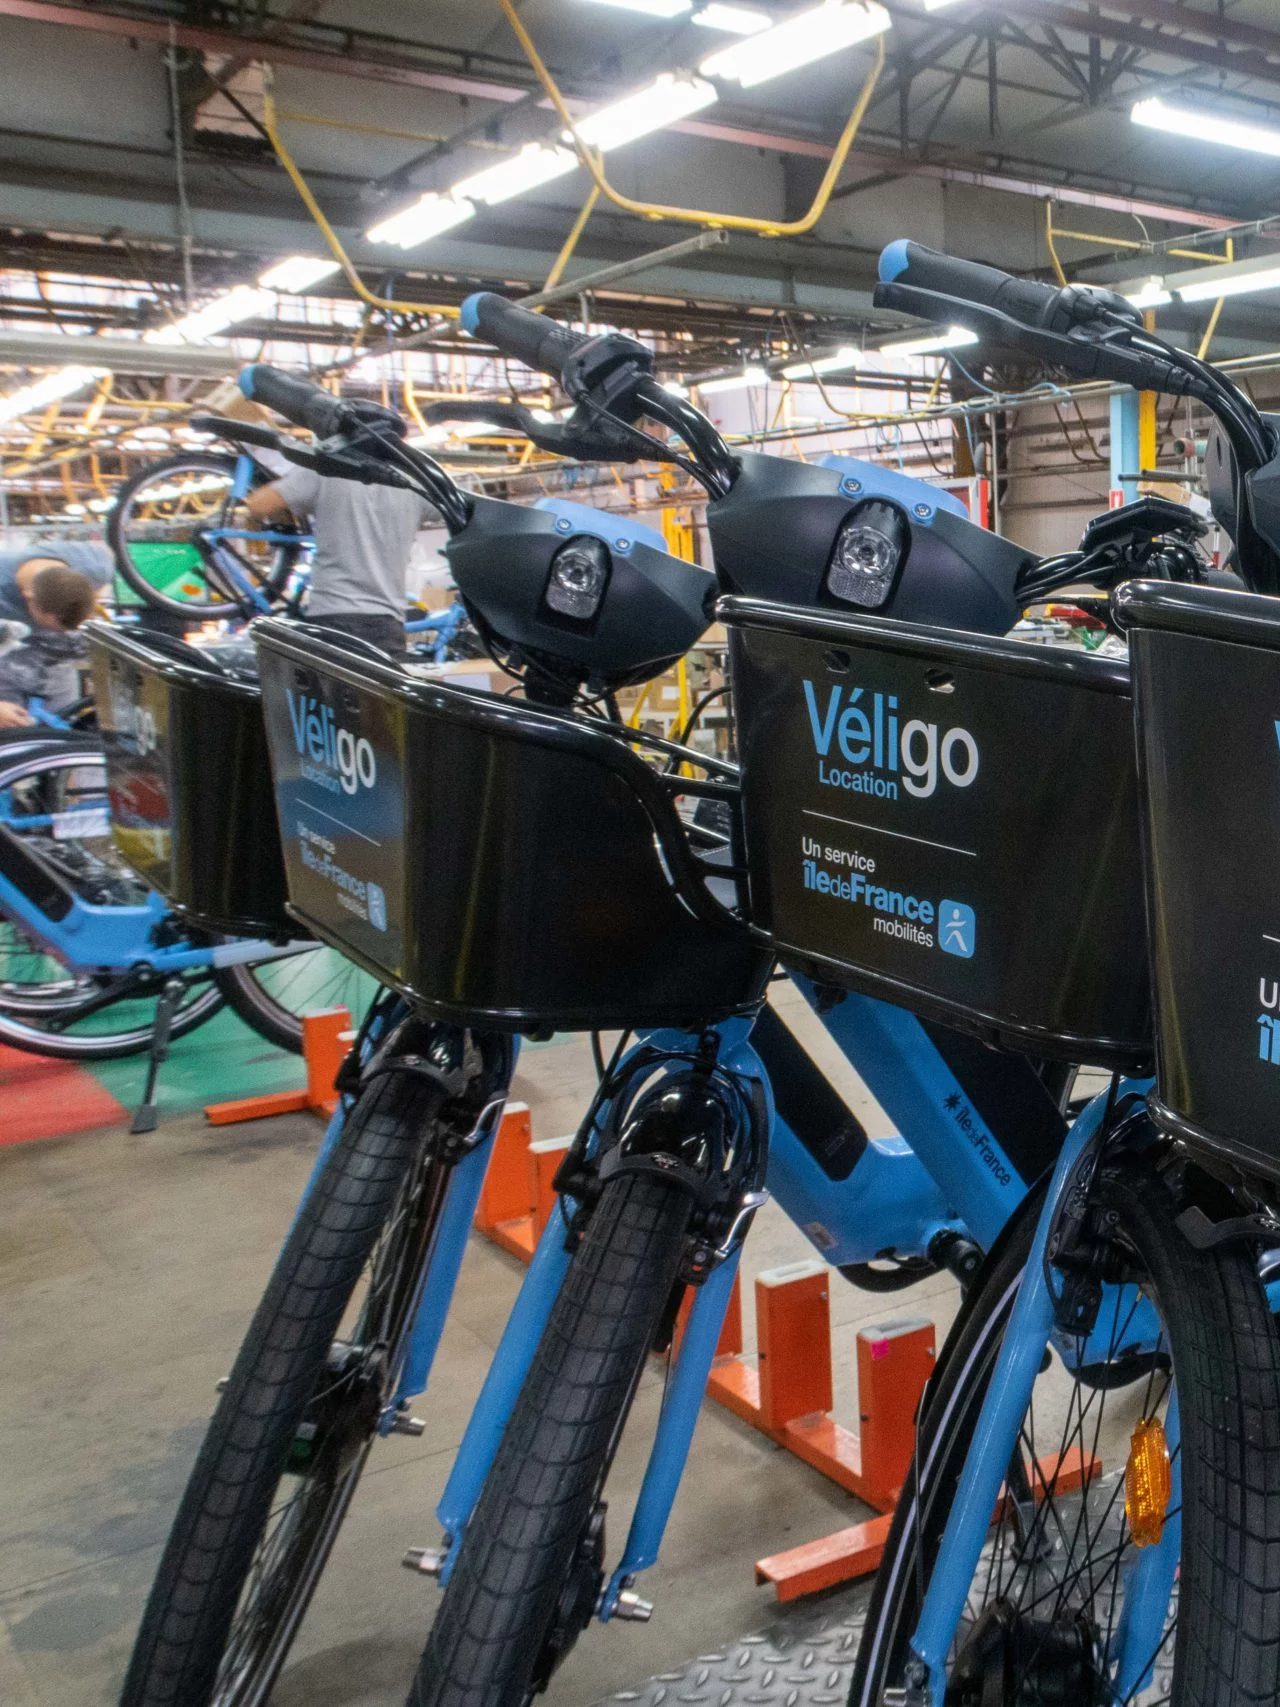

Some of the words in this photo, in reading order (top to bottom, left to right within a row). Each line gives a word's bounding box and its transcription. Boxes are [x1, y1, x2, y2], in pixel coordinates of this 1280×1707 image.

[284, 687, 376, 795] Véligo
[802, 679, 980, 799] Véligo
[819, 759, 898, 801] Location
[801, 836, 822, 859] Un
[824, 846, 876, 873] service
[873, 917, 934, 948] mobilités
